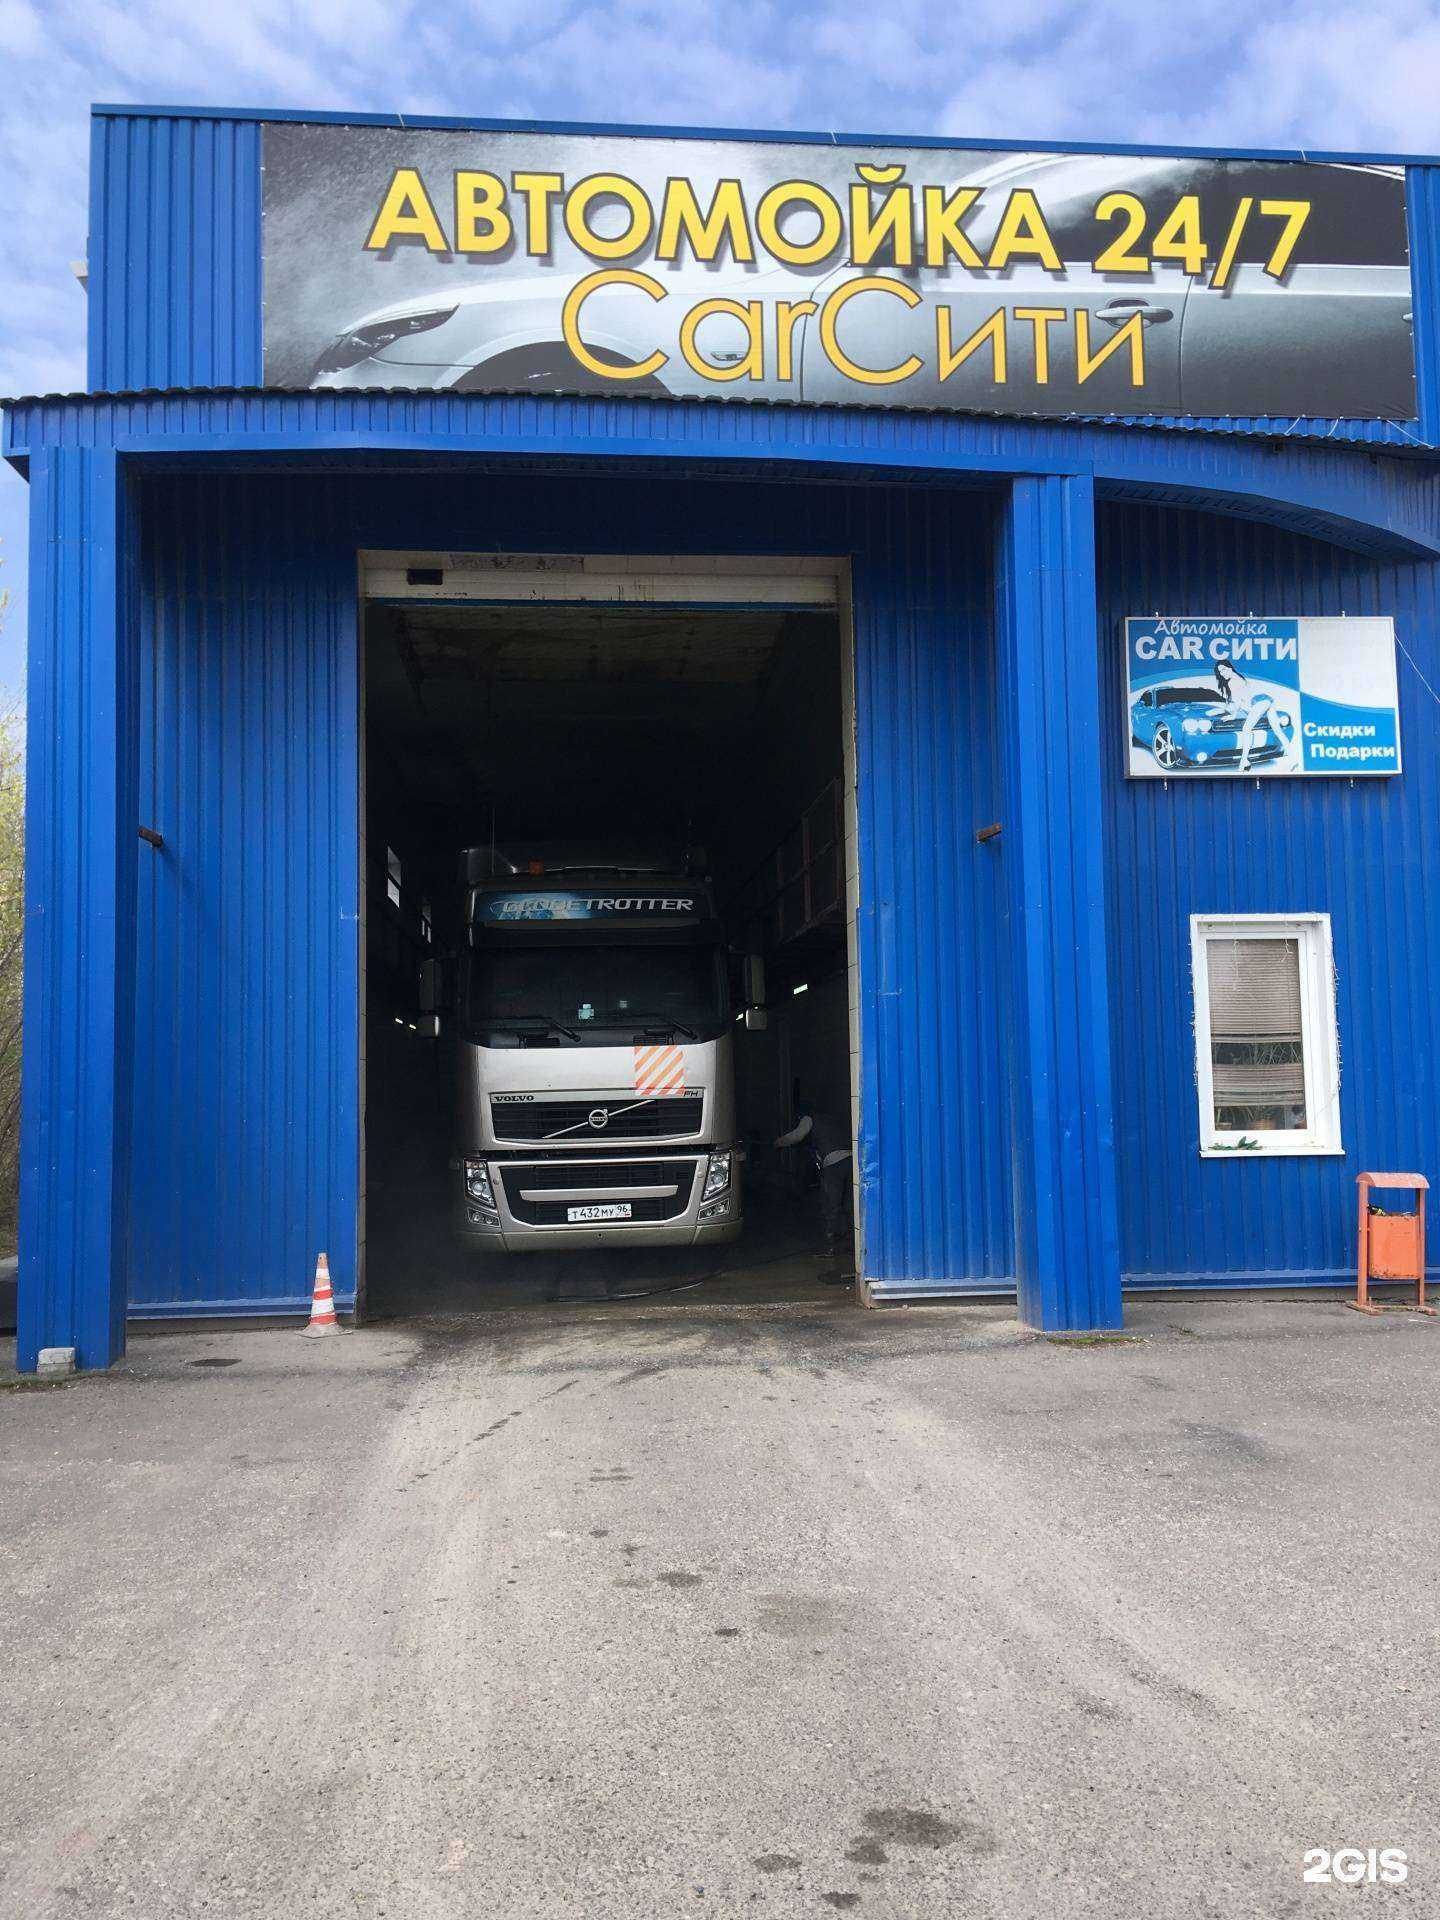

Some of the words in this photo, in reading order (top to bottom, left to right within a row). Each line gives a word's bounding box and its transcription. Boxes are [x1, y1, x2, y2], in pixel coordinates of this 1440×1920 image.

[363, 163, 1065, 272] АВТОМОЙКА
[1092, 191, 1310, 290] 24/7
[1154, 617, 1268, 635] Автомойка
[1304, 722, 1376, 739] Скидки
[1311, 743, 1395, 760] Подарки
[494, 1094, 535, 1102] VOLVO
